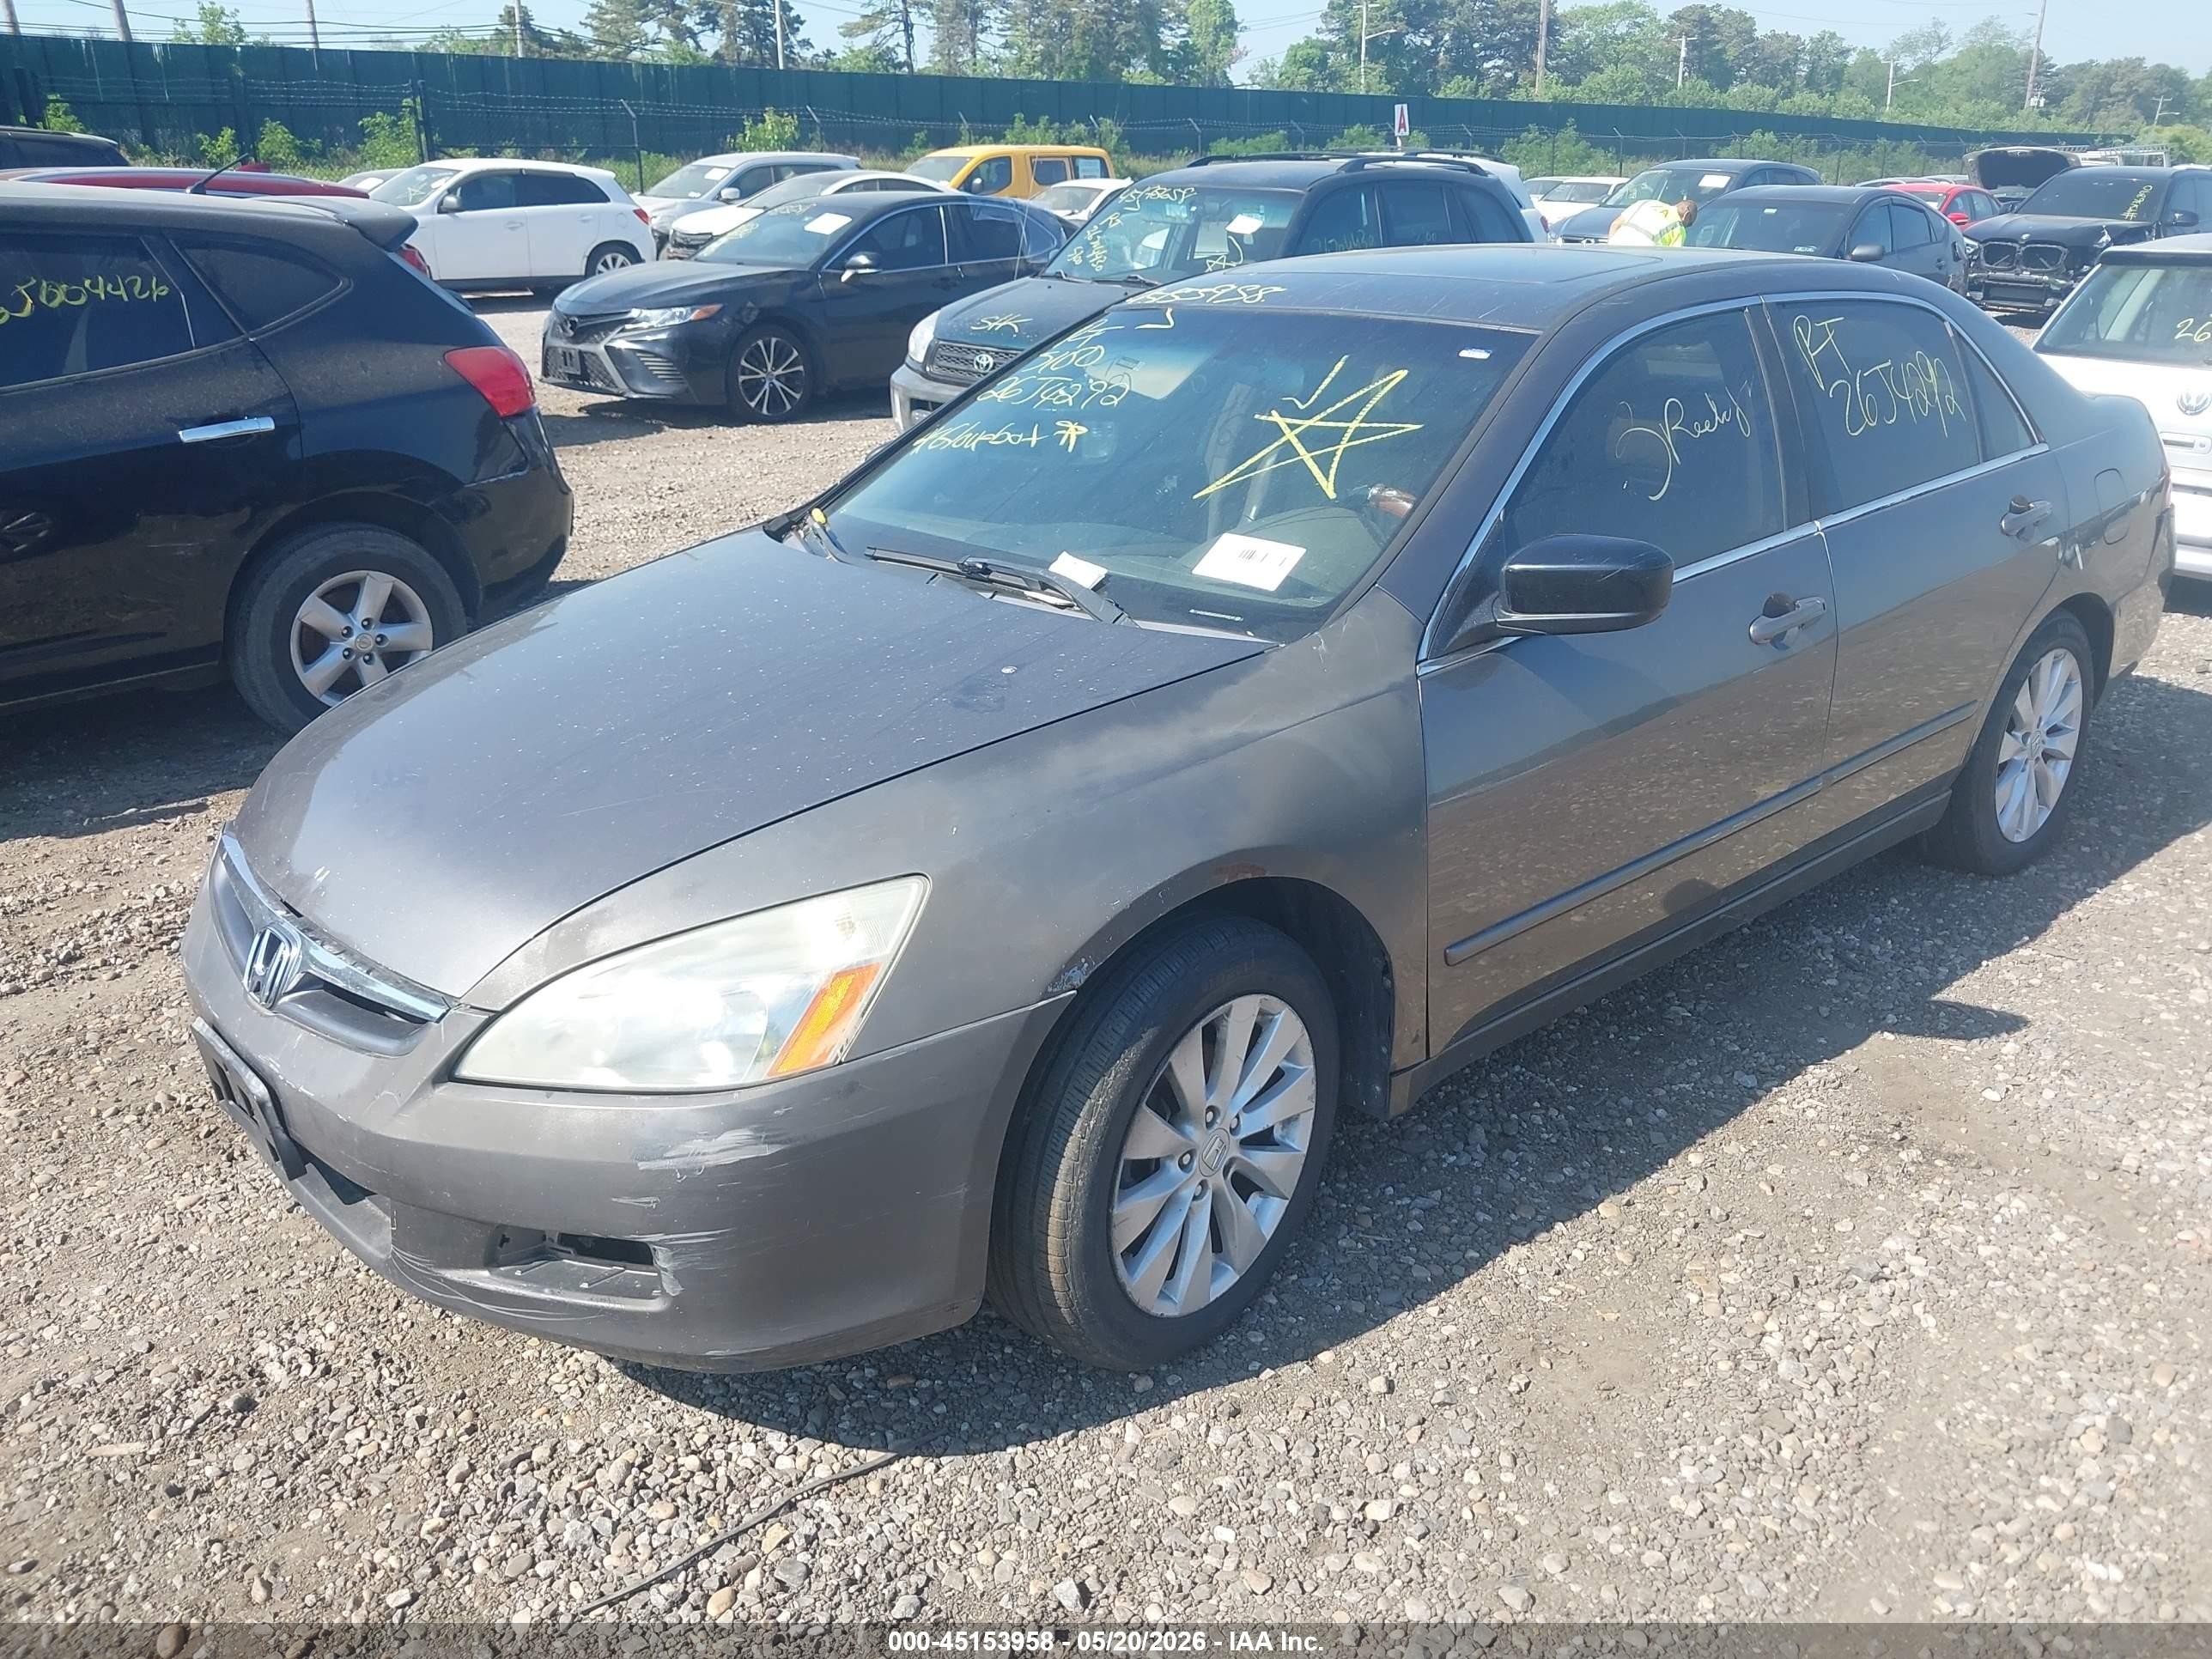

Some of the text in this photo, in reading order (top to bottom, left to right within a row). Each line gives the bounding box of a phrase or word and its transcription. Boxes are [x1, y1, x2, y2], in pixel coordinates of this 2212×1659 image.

[1398, 105, 1407, 133] A
[1793, 314, 1852, 392] RT
[1829, 350, 1966, 438] 26J4292
